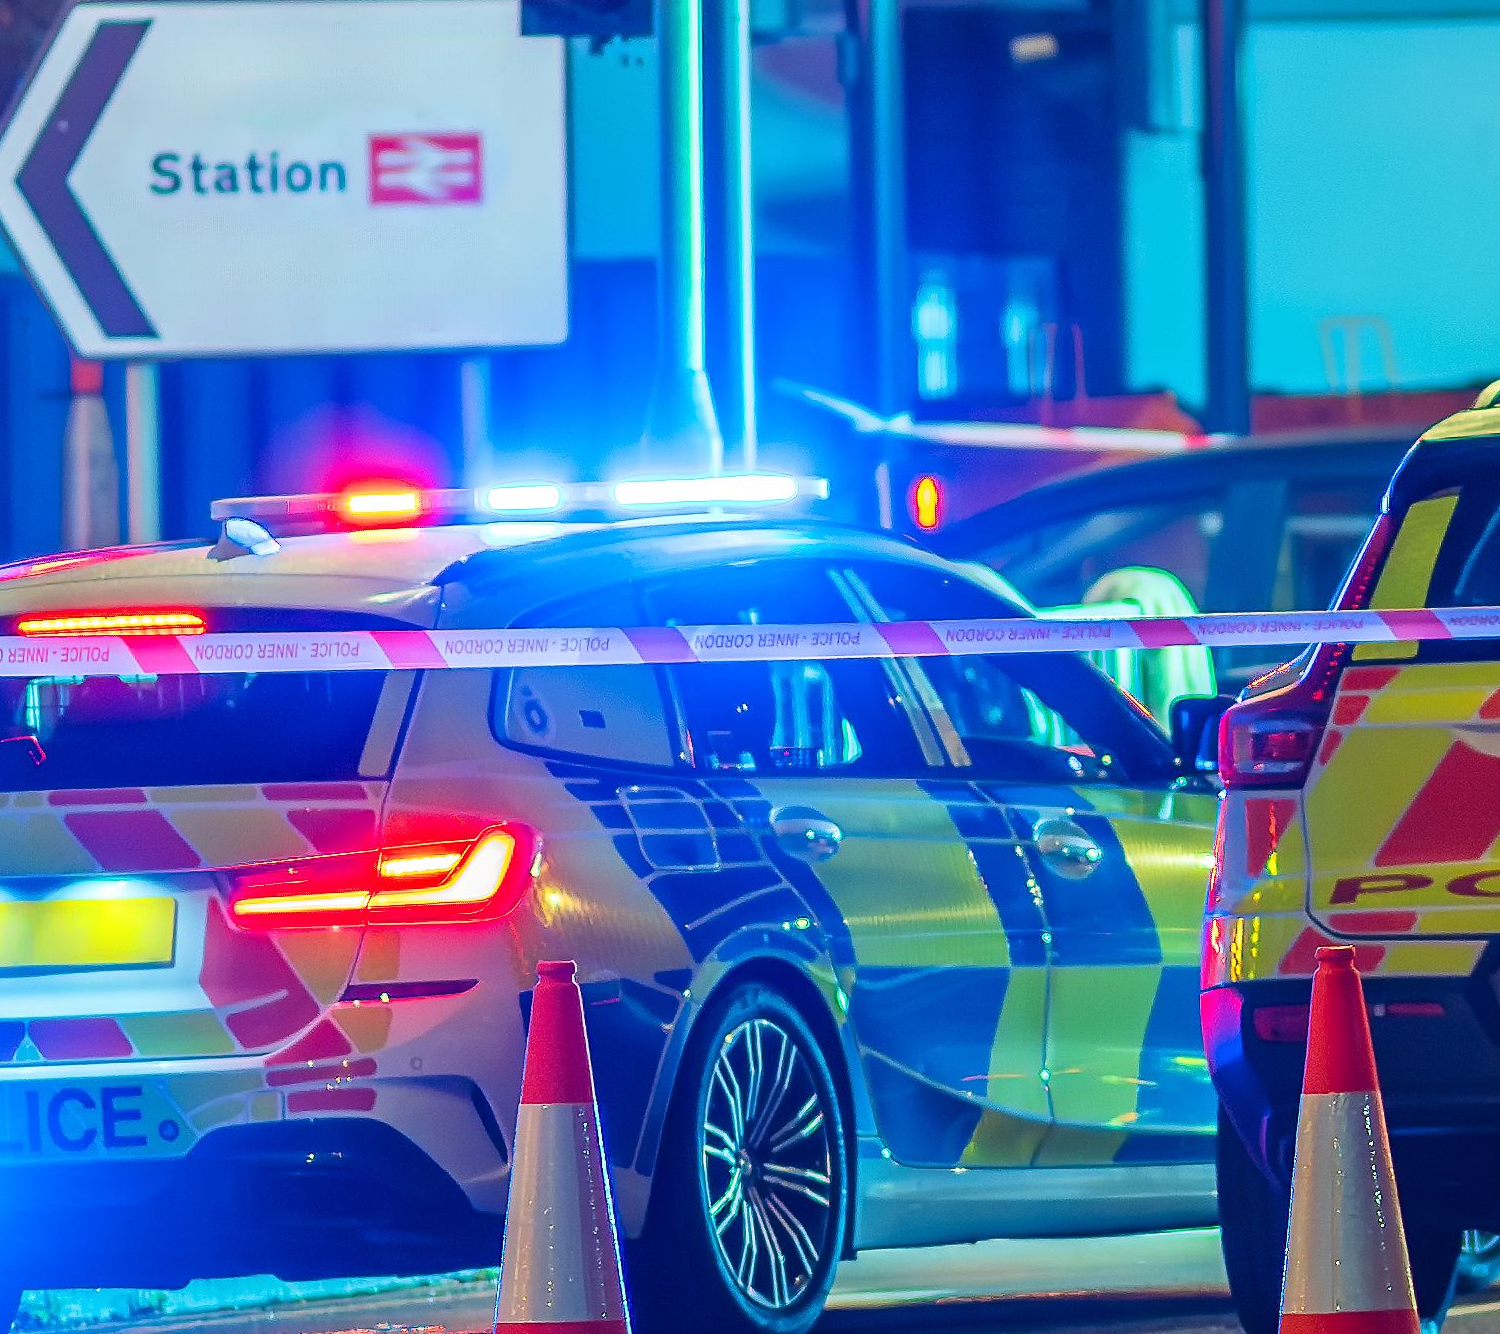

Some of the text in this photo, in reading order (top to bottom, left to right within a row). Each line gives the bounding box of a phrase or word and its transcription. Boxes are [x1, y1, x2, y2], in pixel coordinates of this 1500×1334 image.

[150, 151, 346, 195] Station
[444, 639, 503, 654] CORDON
[507, 638, 548, 653] INNER
[560, 637, 610, 652] POLICE
[694, 634, 754, 649] CORDON
[758, 633, 800, 648] INNER
[812, 632, 861, 646] POLICE
[8, 647, 48, 663] INNER
[60, 647, 110, 663] POLICE
[195, 643, 254, 660] CORDON
[257, 643, 298, 659] INNER
[310, 642, 360, 657] POLICE
